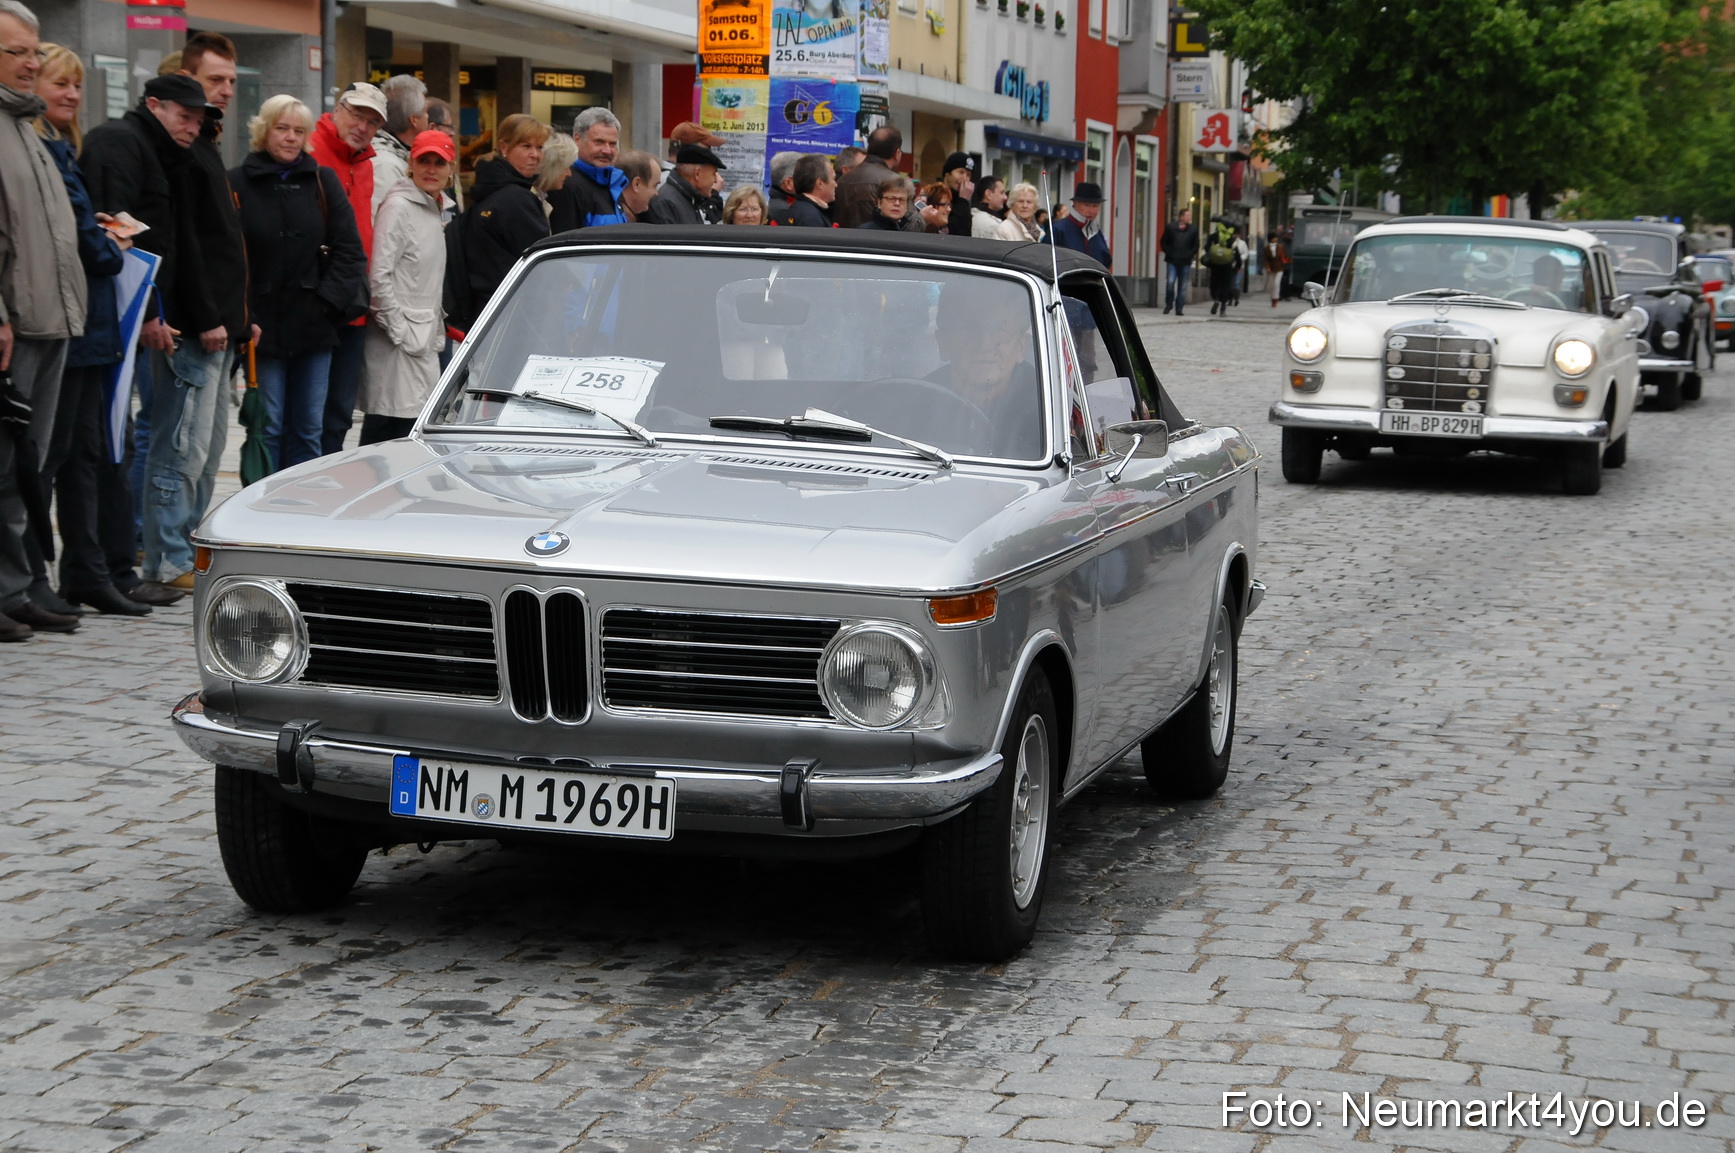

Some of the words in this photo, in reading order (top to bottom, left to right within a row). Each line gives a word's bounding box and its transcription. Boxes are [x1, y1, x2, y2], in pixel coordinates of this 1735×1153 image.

[709, 14, 757, 25] Samstag
[709, 29, 755, 41] 01.06.
[776, 11, 804, 47] ZAZ
[808, 23, 837, 43] OPEN
[840, 19, 855, 37] AIR
[703, 54, 763, 65] Volksfestplatz
[775, 49, 809, 61] 25.6.
[827, 51, 856, 60] Abenberg
[534, 72, 586, 89] FRIES
[1177, 73, 1203, 82] Stern
[783, 99, 833, 126] G6
[723, 121, 728, 129] 2.
[730, 121, 744, 130] Juni
[746, 122, 765, 131] 2013
[575, 371, 626, 391] 258
[1391, 415, 1410, 431] HH
[1421, 416, 1440, 432] BP
[1442, 418, 1481, 434] 829H
[400, 791, 409, 804] D
[418, 764, 469, 814] NM
[499, 773, 525, 819] M
[534, 777, 670, 831] 1969H
